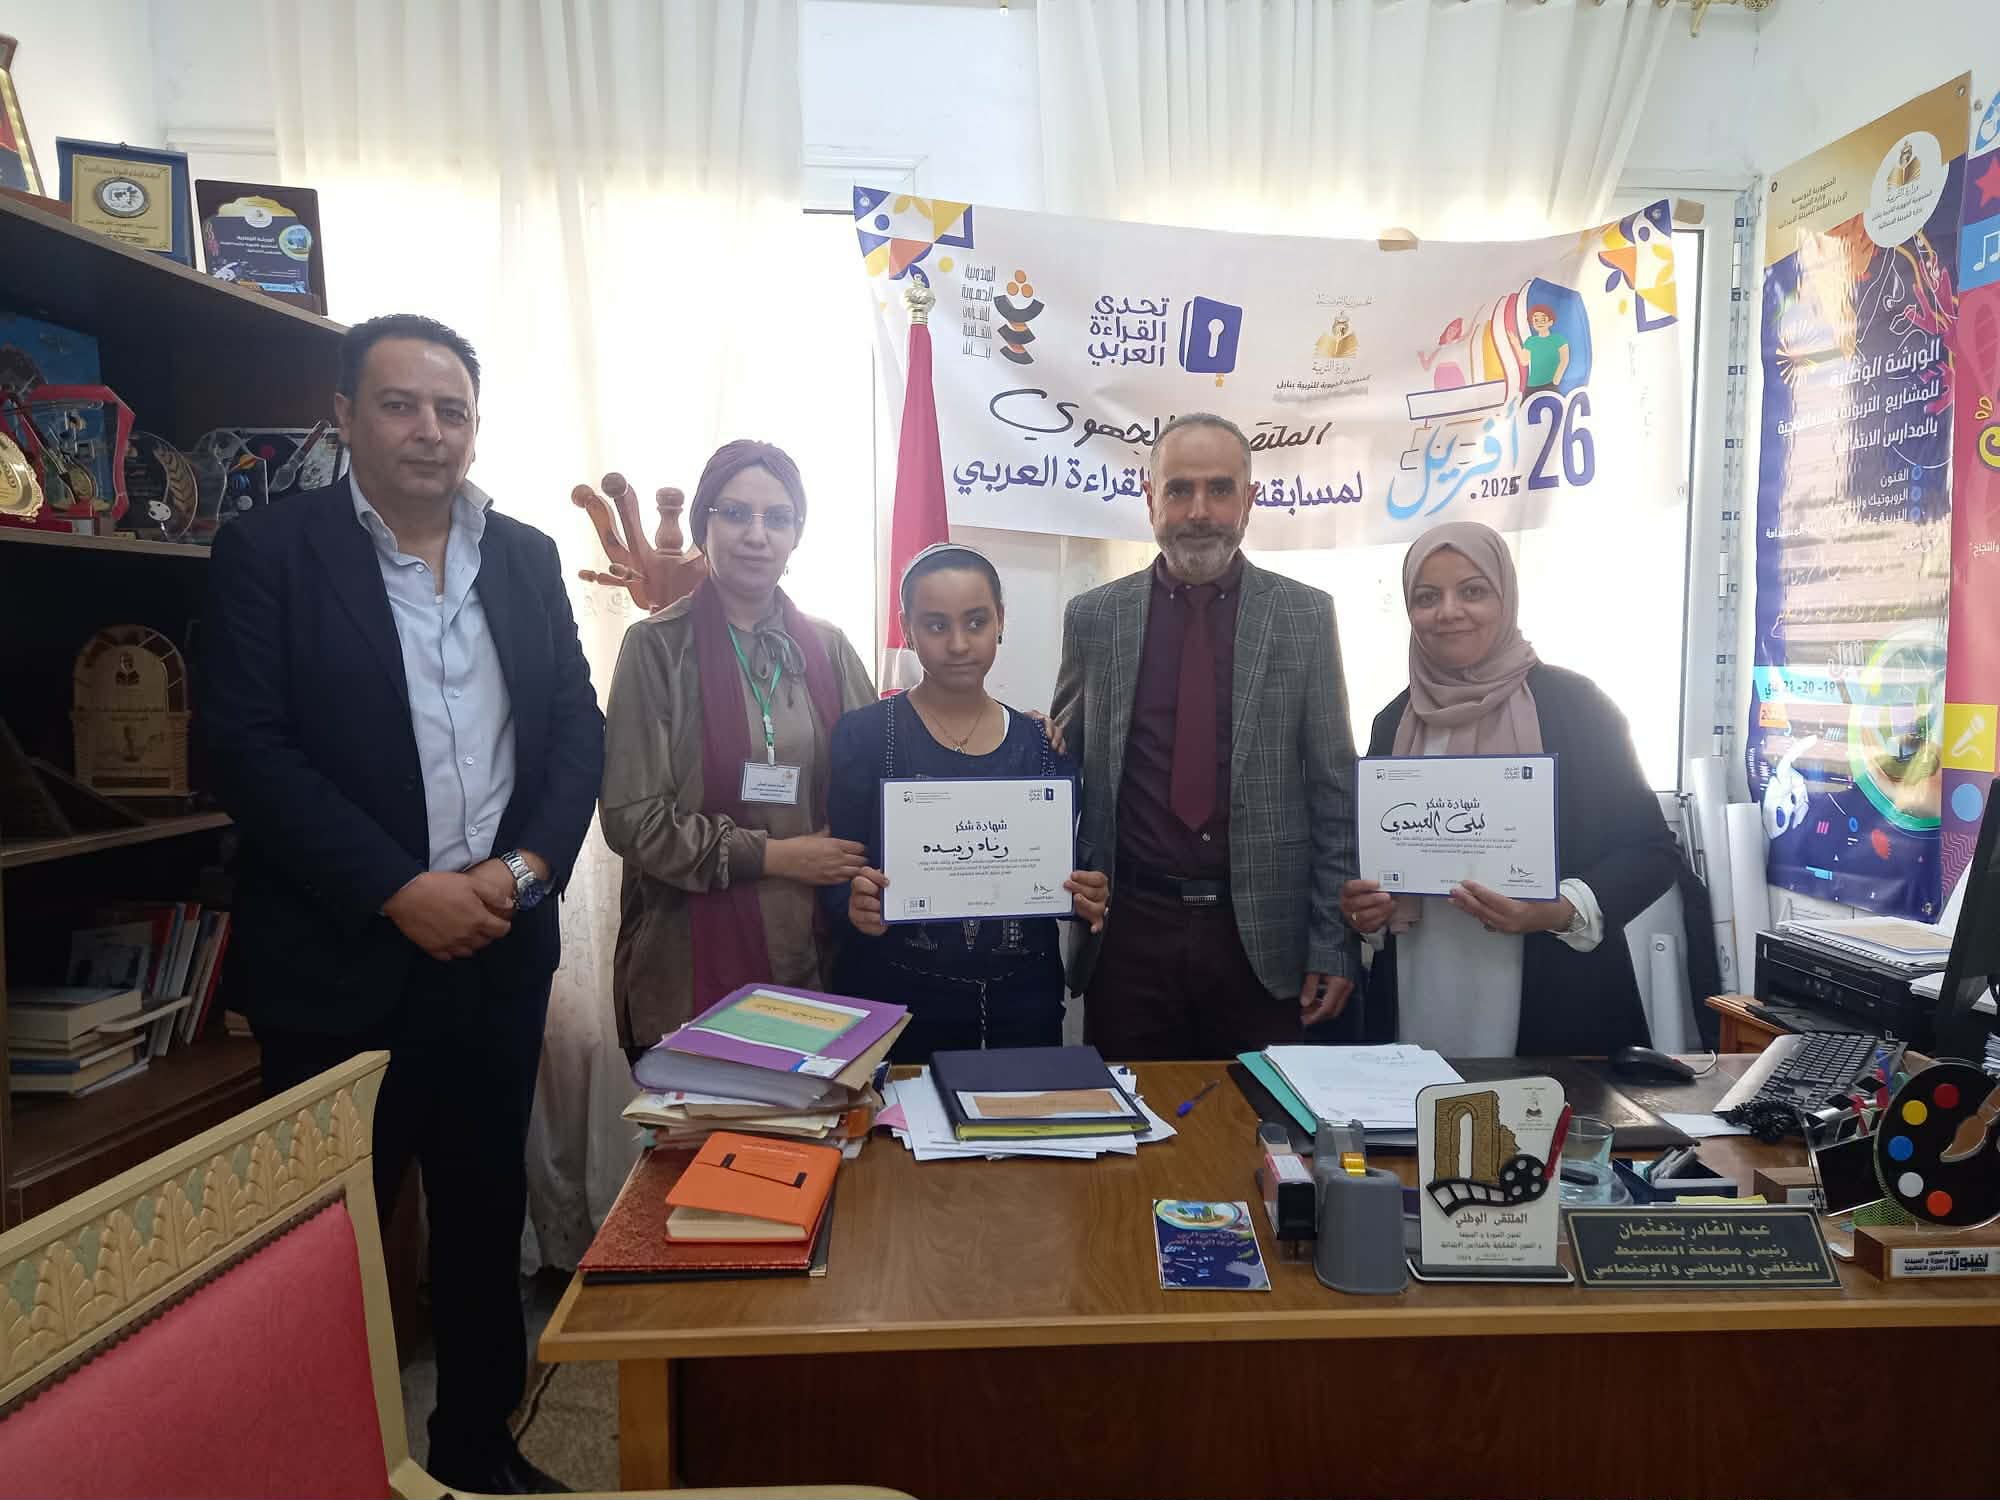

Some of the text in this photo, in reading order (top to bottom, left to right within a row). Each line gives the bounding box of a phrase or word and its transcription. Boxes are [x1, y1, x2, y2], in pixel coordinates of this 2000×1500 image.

[1095, 296, 1170, 319] تحدي
[1090, 316, 1166, 343] القراءة
[1088, 342, 1165, 367] العربي
[1885, 338, 1940, 374] الورشة
[1885, 379, 1939, 413] للمشاريع
[1250, 421, 1332, 452] الملتق
[1882, 416, 1938, 447] بالمدارس
[1387, 391, 1595, 520] 26 أفريل
[953, 454, 1057, 495] العربي
[1880, 468, 1909, 488] الفنون
[1425, 797, 1480, 811] شهادة شكر
[955, 819, 1008, 833] شهادة شكر
[1380, 802, 1441, 836] العبيدي
[1456, 1210, 1487, 1229] الوطني
[1690, 1219, 1734, 1239] القادر
[1739, 1222, 1770, 1240] عبد
[1614, 1243, 1788, 1258] رئيس مصلحة التنشيط
[1671, 1264, 1681, 1276] و
[1685, 1263, 1743, 1278] الرياضي
[1747, 1263, 1756, 1276] و
[1759, 1261, 1820, 1279] الثقافي
